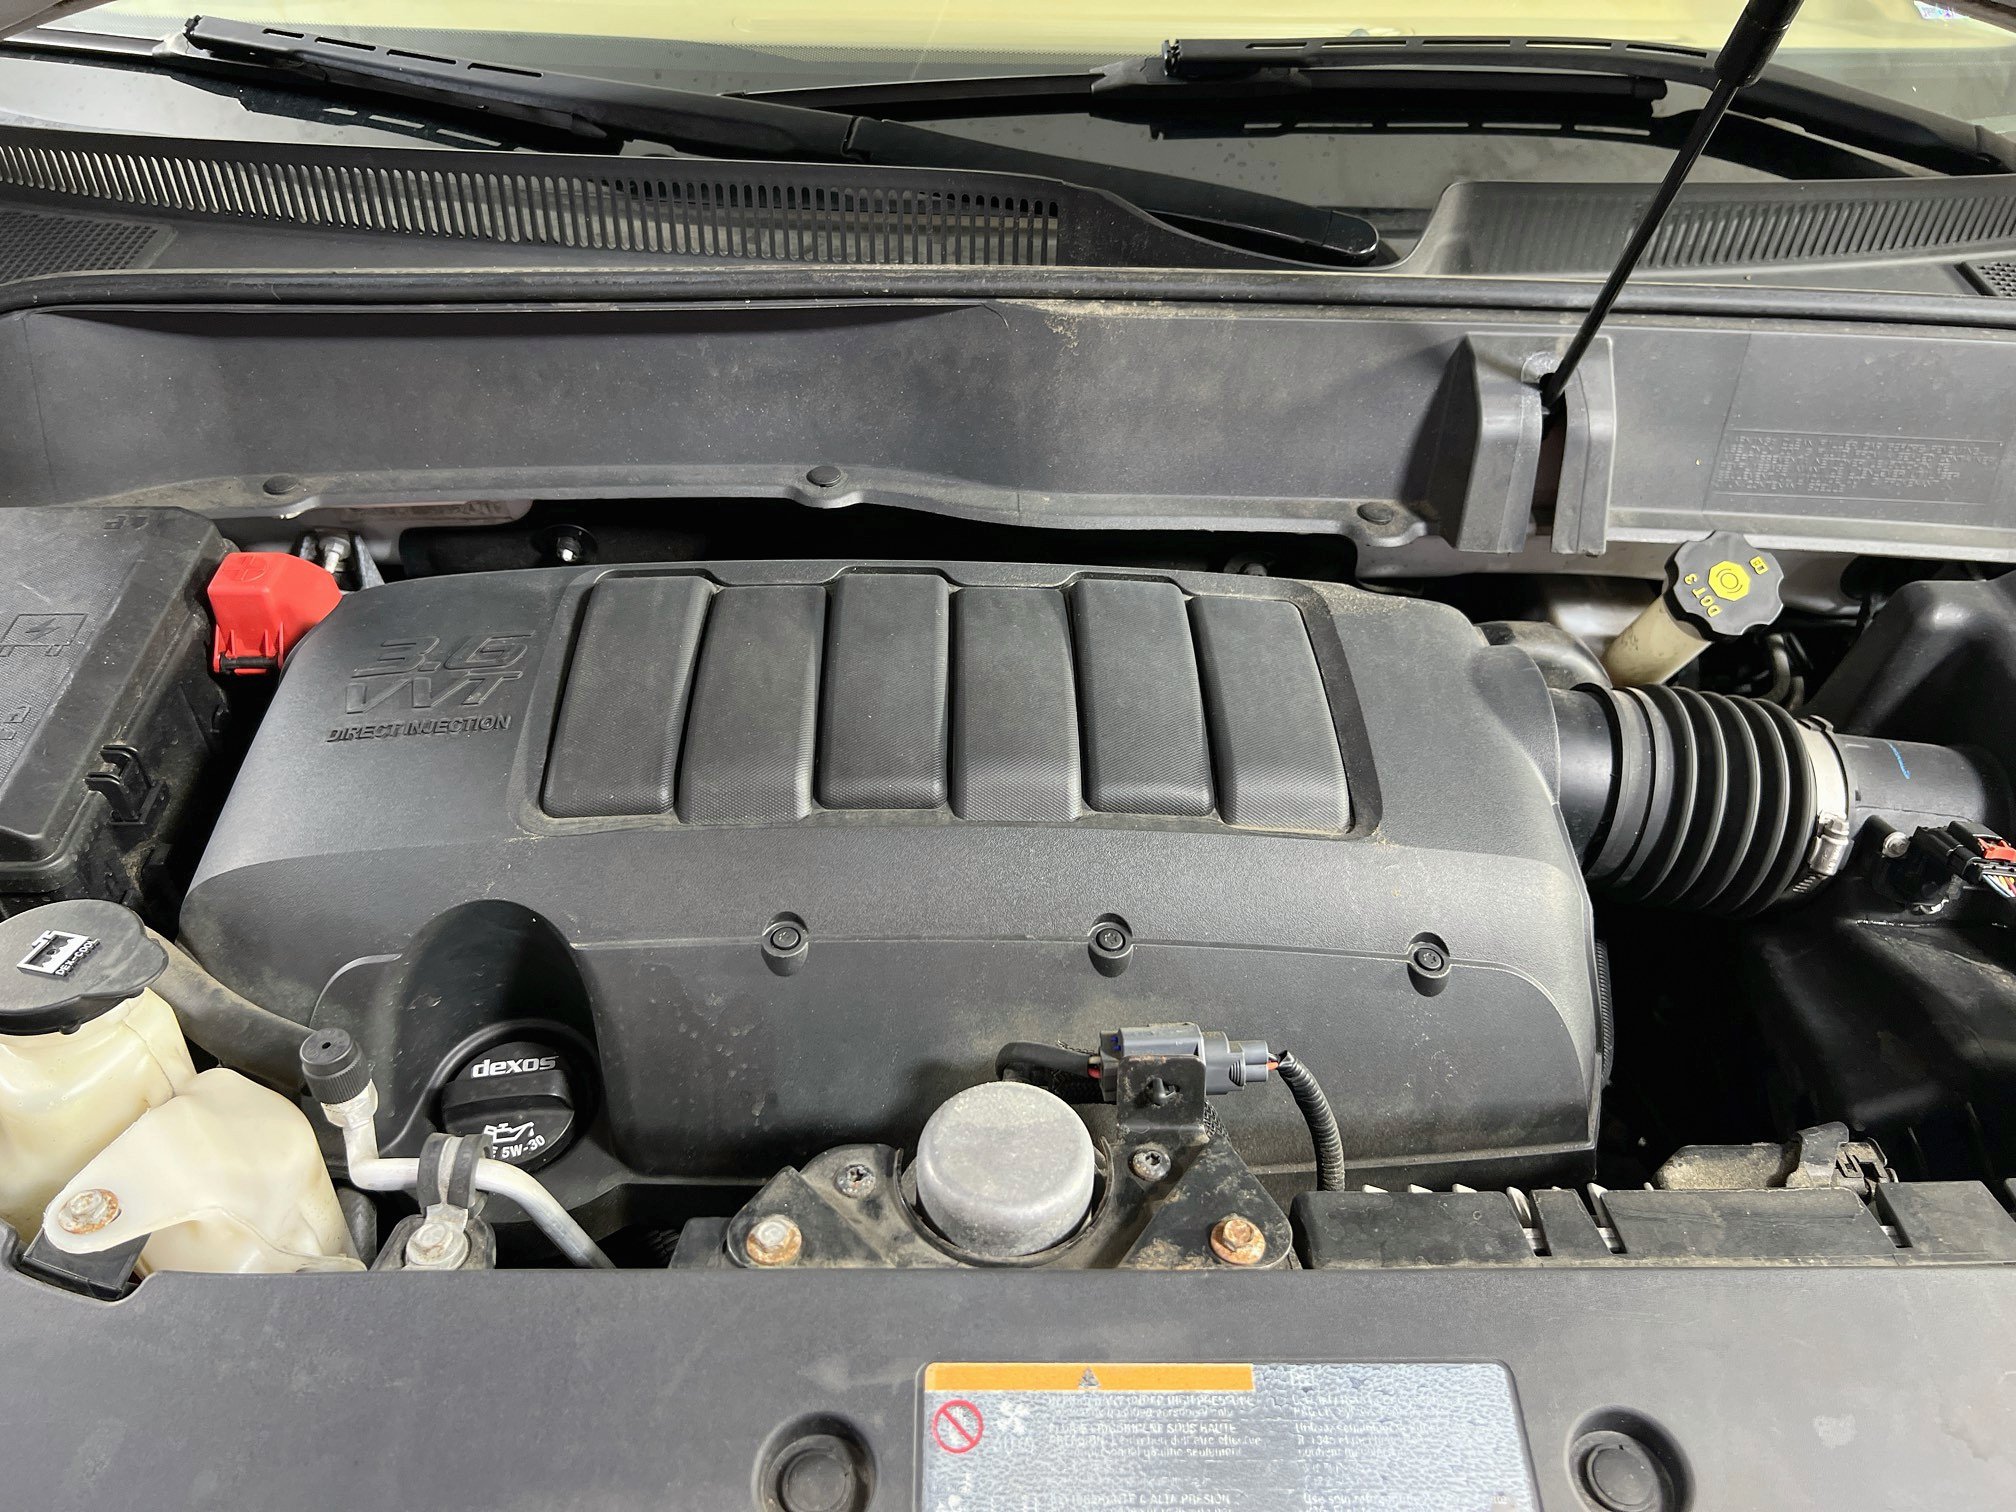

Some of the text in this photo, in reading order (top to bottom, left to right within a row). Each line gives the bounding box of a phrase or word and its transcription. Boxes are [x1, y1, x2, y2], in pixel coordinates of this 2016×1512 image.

[1684, 573, 1722, 617] DOT 3
[351, 631, 536, 679] 3.6
[345, 670, 524, 714] VVT
[55, 938, 101, 977] DEX-COOL
[471, 1055, 560, 1079] dexos
[501, 1134, 546, 1159] 5W-30
